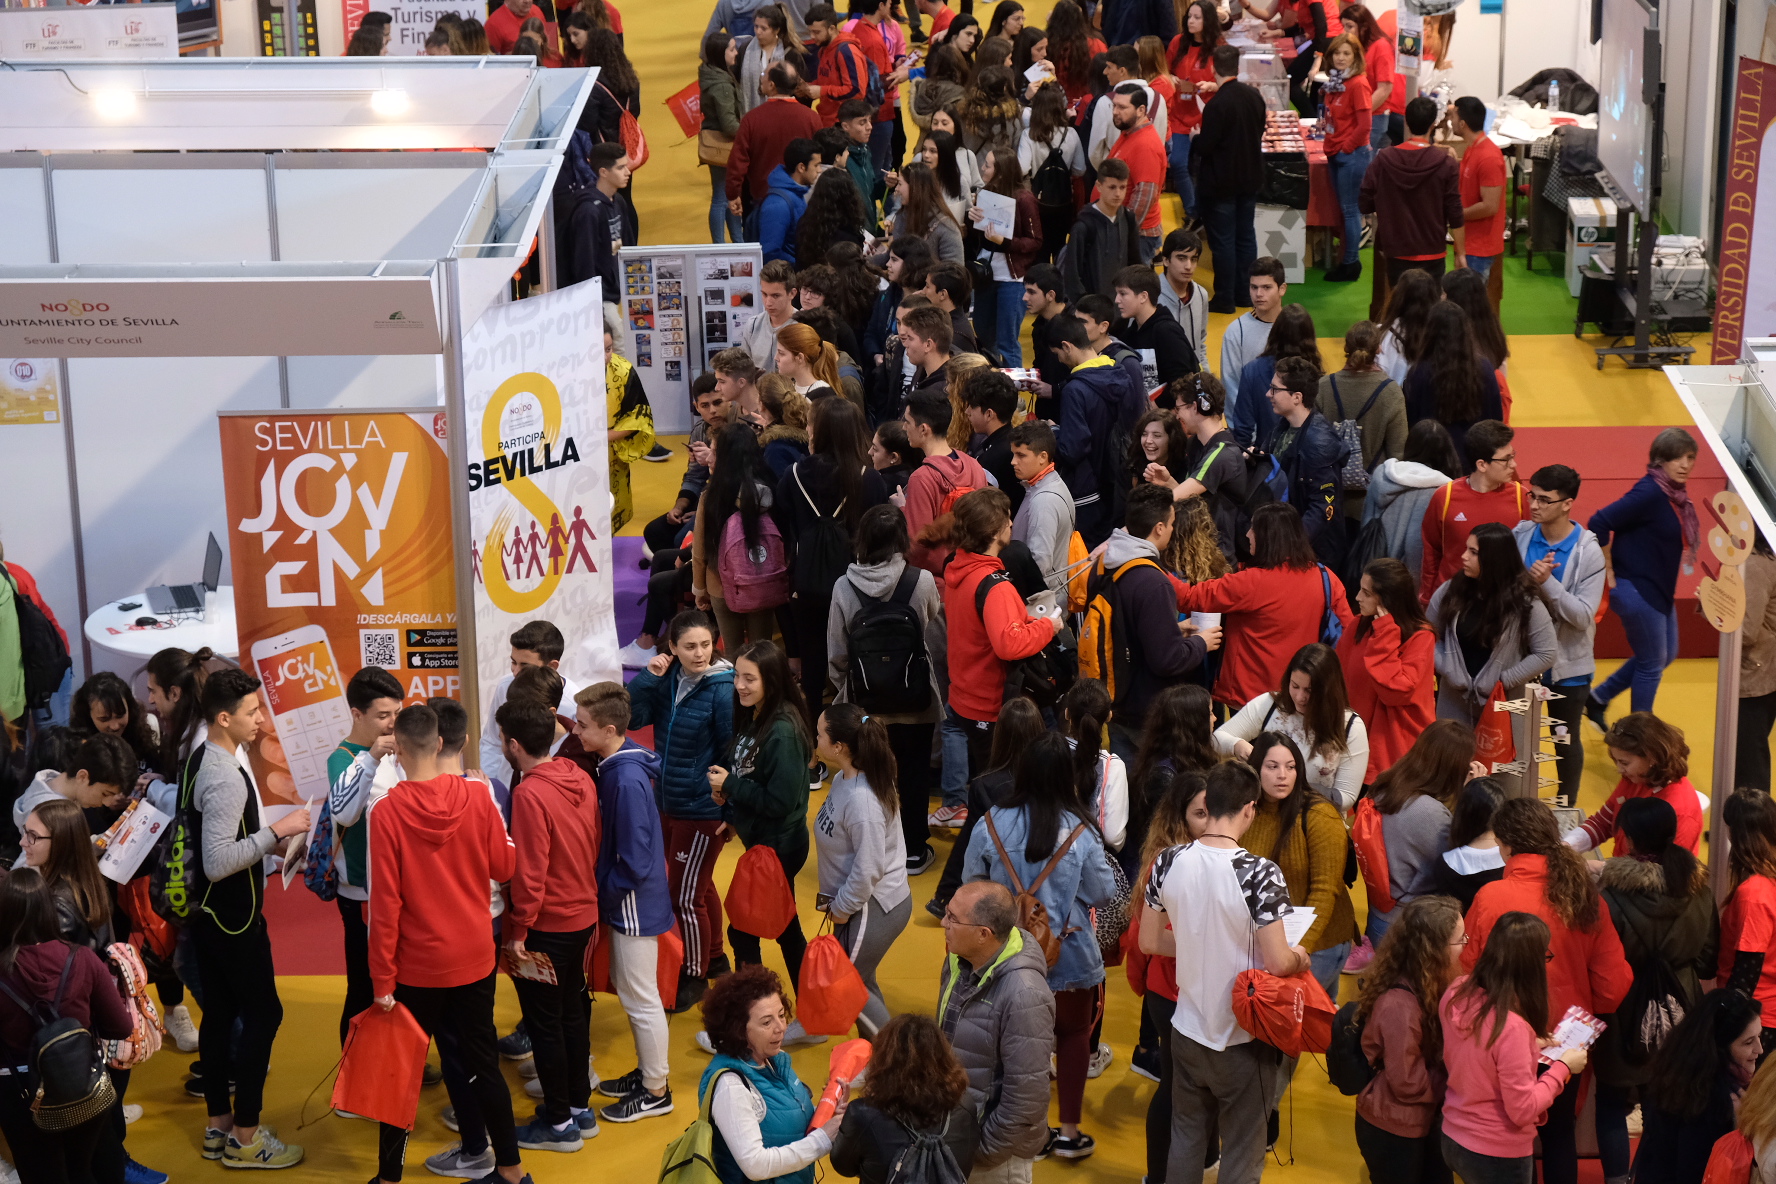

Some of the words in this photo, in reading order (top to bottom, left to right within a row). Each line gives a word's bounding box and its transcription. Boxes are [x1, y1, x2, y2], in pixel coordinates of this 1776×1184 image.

[1731, 65, 1765, 183] SEVILLA
[99, 318, 118, 327] DE
[24, 336, 64, 345] Seville
[67, 336, 91, 346] City
[95, 336, 142, 345] Council
[254, 420, 386, 451] SEVILLA
[497, 430, 546, 452] PARTICIPA
[468, 436, 581, 492] SEVILLA
[357, 611, 443, 624] !DESCÁRGALA
[424, 636, 446, 645] Google
[424, 658, 441, 668] App
[262, 669, 280, 705] SEVILLA
